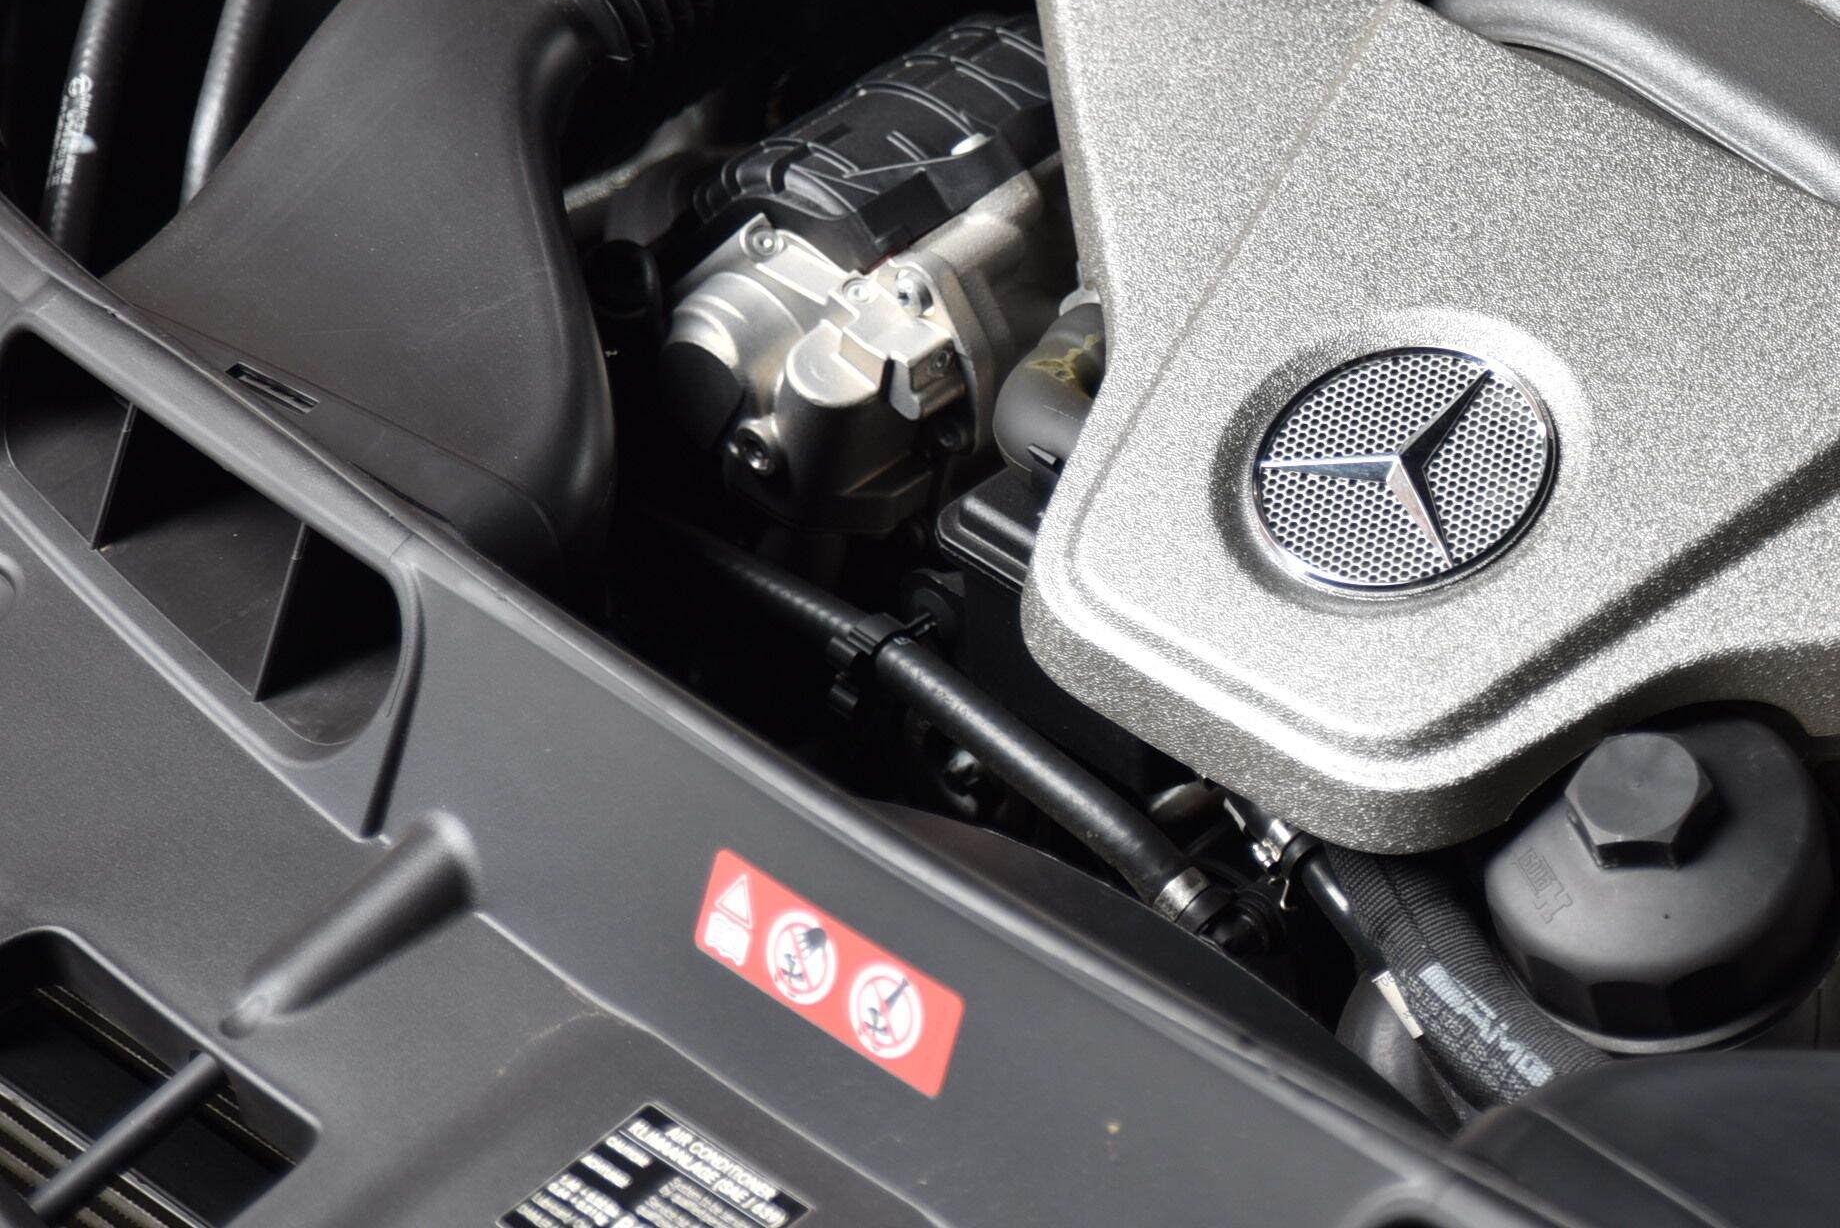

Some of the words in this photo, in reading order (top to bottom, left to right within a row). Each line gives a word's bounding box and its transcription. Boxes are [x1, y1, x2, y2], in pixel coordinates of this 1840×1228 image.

[1419, 962, 1553, 1088] AMG
[663, 1125, 694, 1147] AIR
[688, 1141, 780, 1201] CONDITIONER
